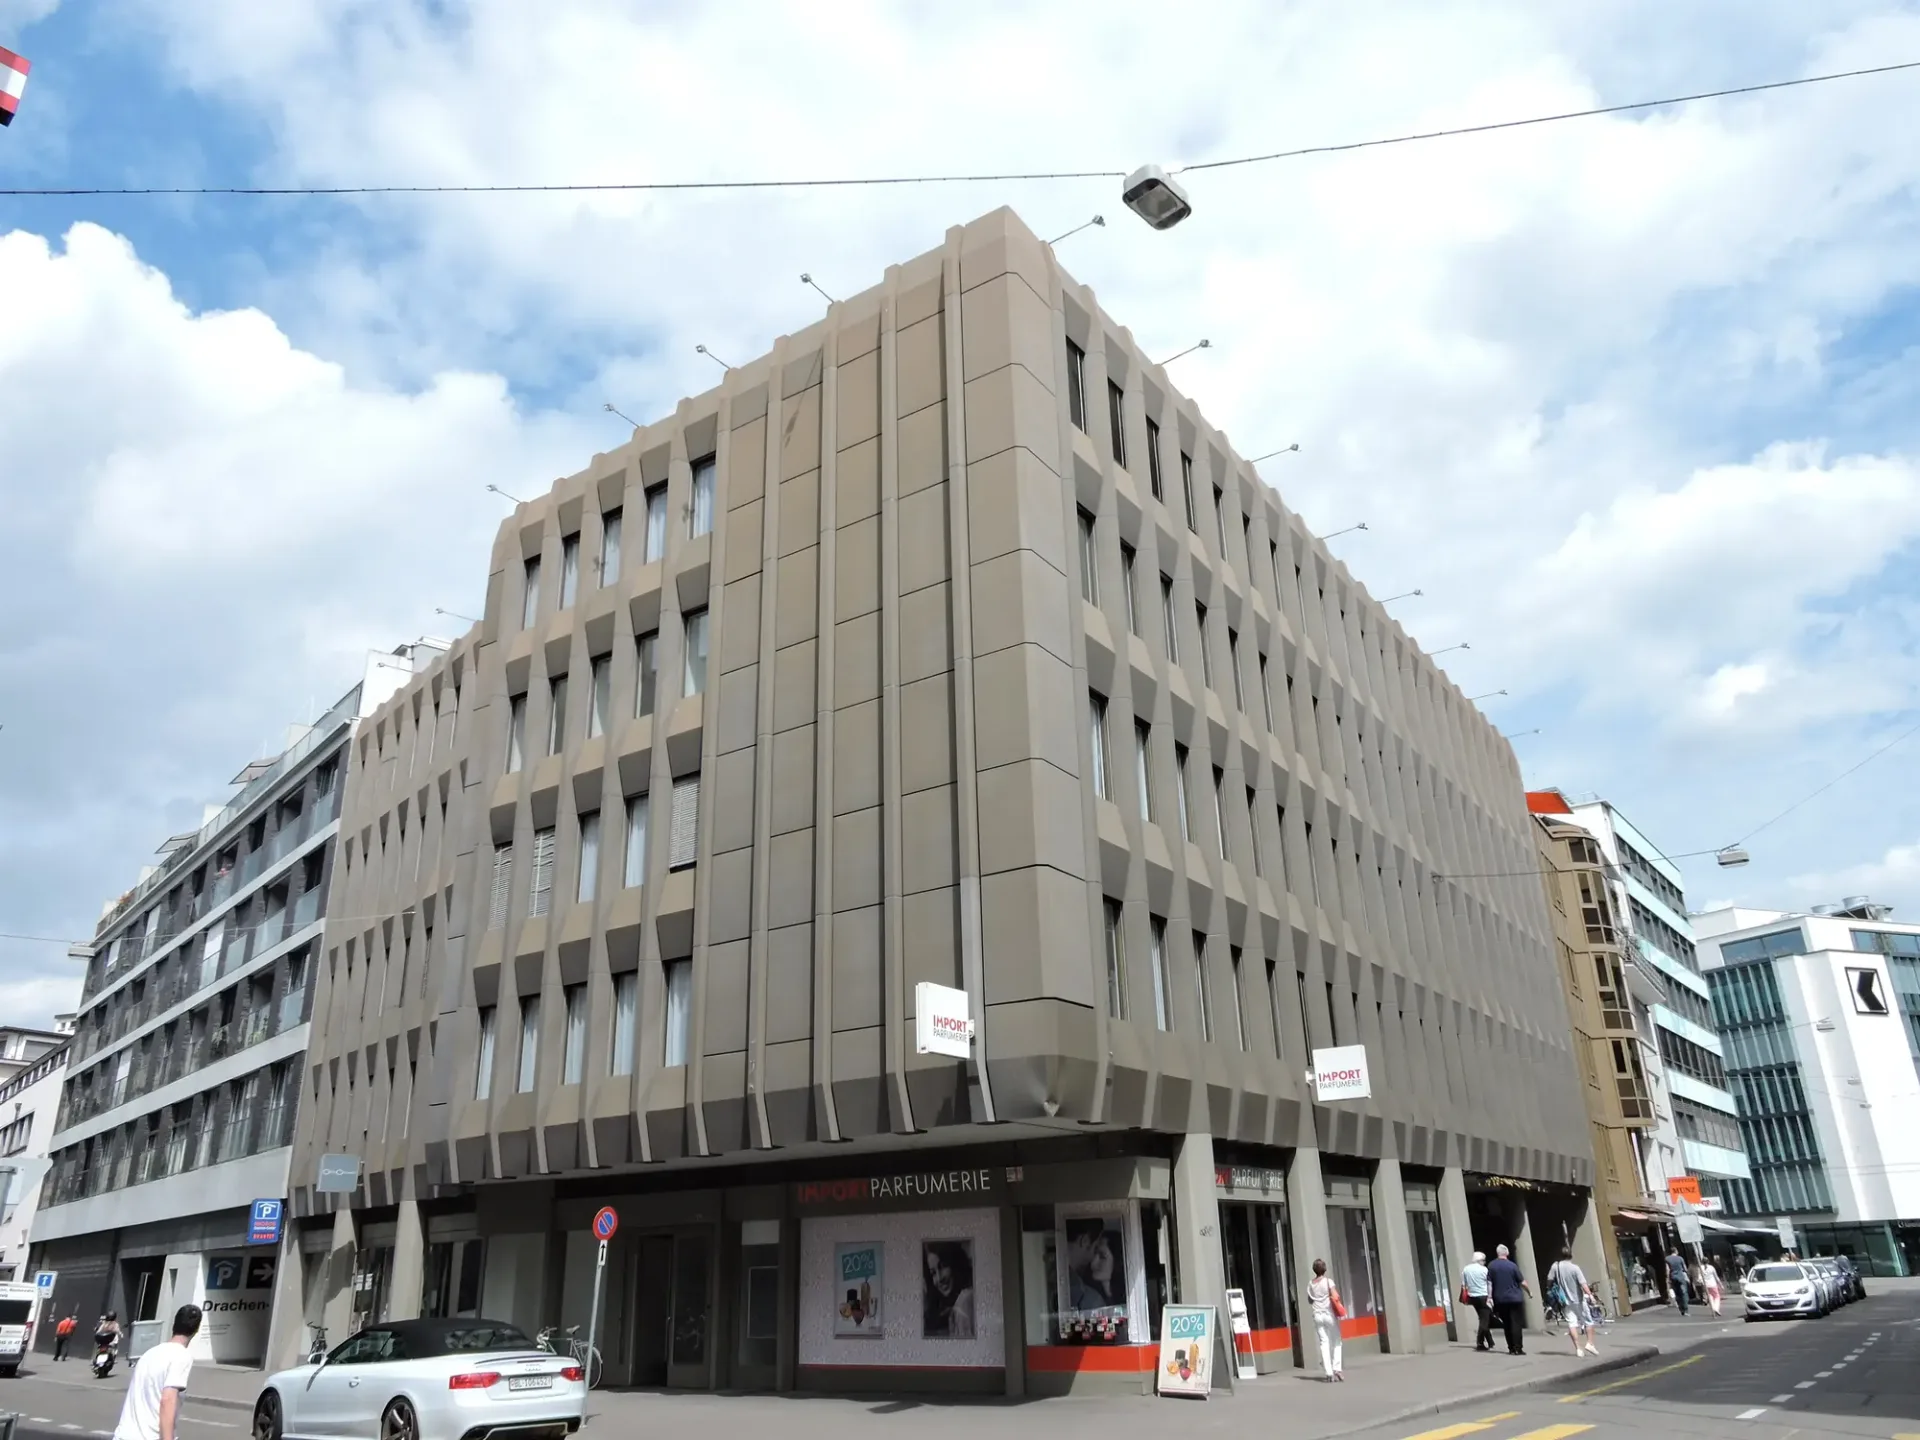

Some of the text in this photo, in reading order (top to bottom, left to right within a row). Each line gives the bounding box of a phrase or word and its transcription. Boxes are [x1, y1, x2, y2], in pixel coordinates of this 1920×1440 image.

[933, 1014, 967, 1033] IMPORT
[933, 1027, 967, 1043] PARFUMERIE
[1318, 1069, 1361, 1082] IMPORT
[1319, 1079, 1363, 1089] PARFUMERIE
[798, 1169, 991, 1203] IMPORT PARFUMERIE
[1231, 1167, 1283, 1189] PARFUMERIE
[843, 1252, 874, 1274] 20%
[202, 1298, 270, 1312] Drachen-
[1171, 1315, 1204, 1333] 20%
